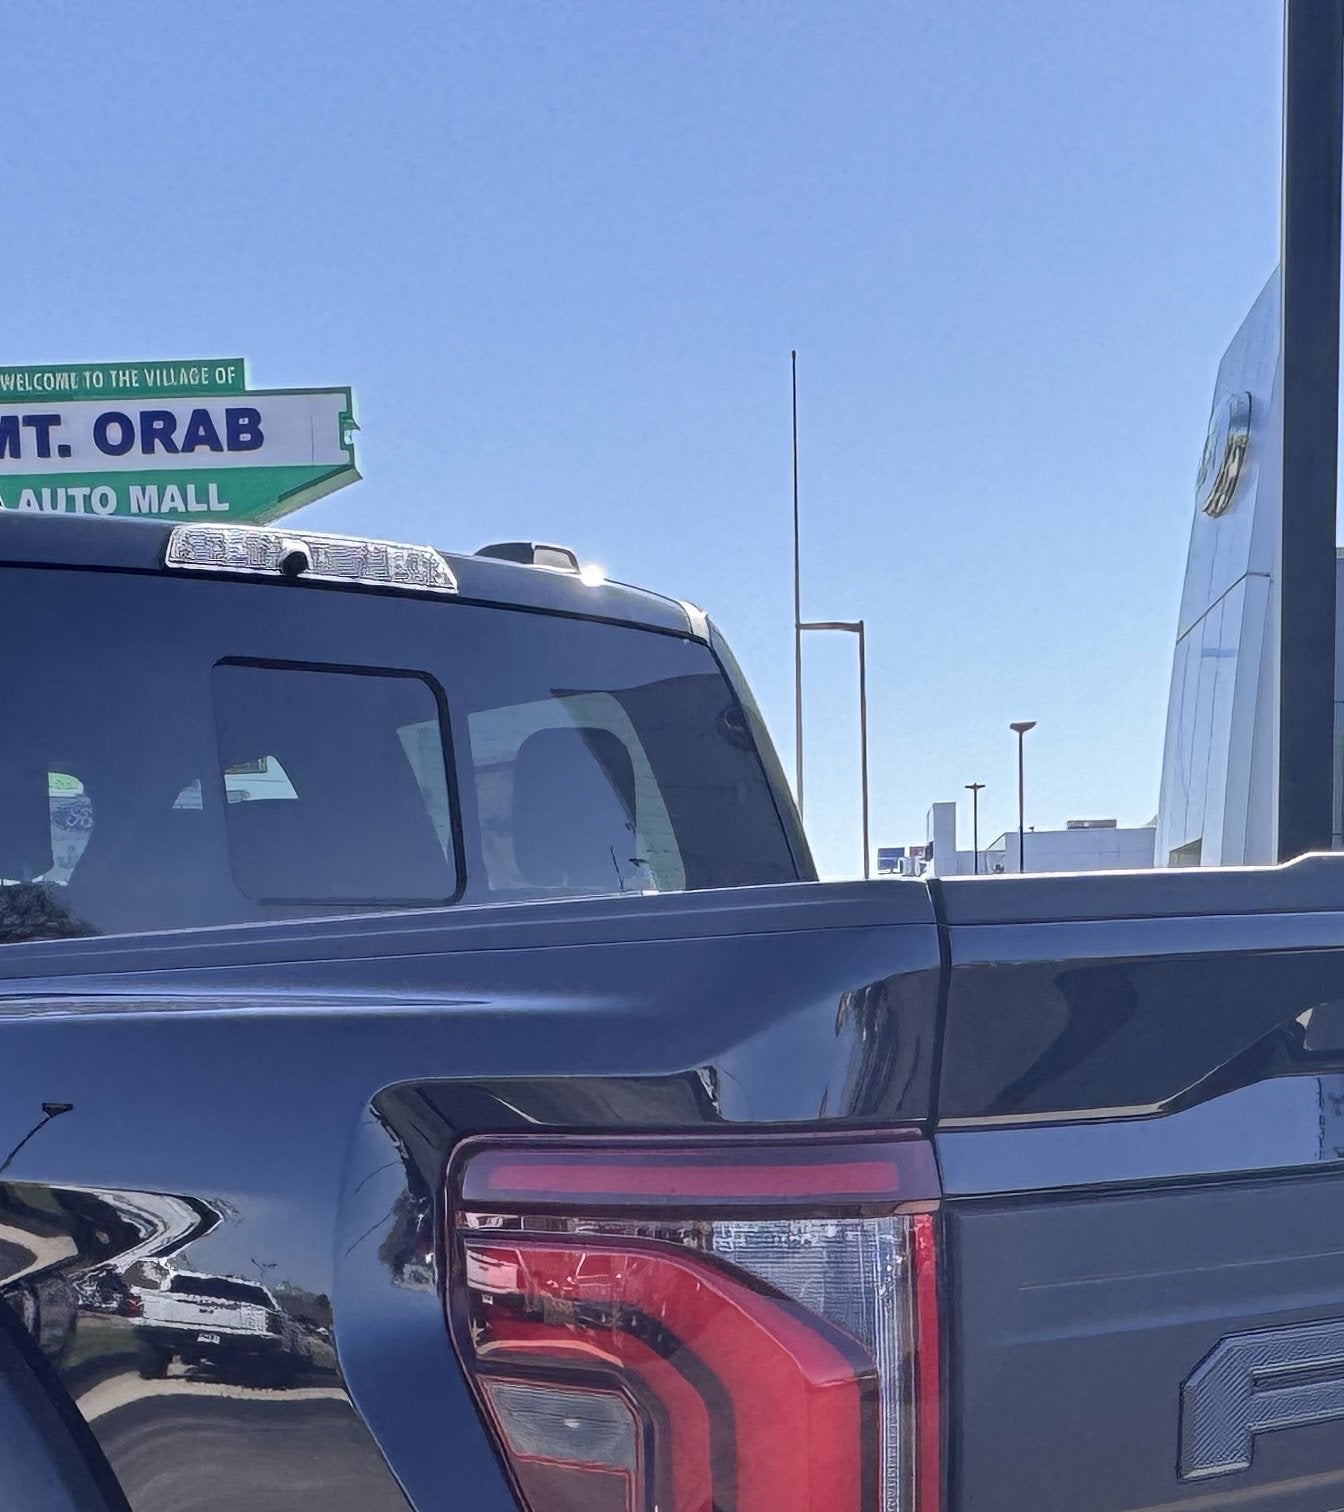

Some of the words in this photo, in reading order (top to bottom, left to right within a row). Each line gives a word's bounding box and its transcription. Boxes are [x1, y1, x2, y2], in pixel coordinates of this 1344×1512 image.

[0, 371, 78, 391] WELCOME
[84, 370, 104, 389] TO
[109, 369, 139, 388] THE
[144, 367, 209, 387] VILLAGE
[215, 366, 236, 384] OF
[93, 407, 265, 456] ORAB
[18, 485, 118, 515] AUTO
[129, 483, 230, 514] MALL
